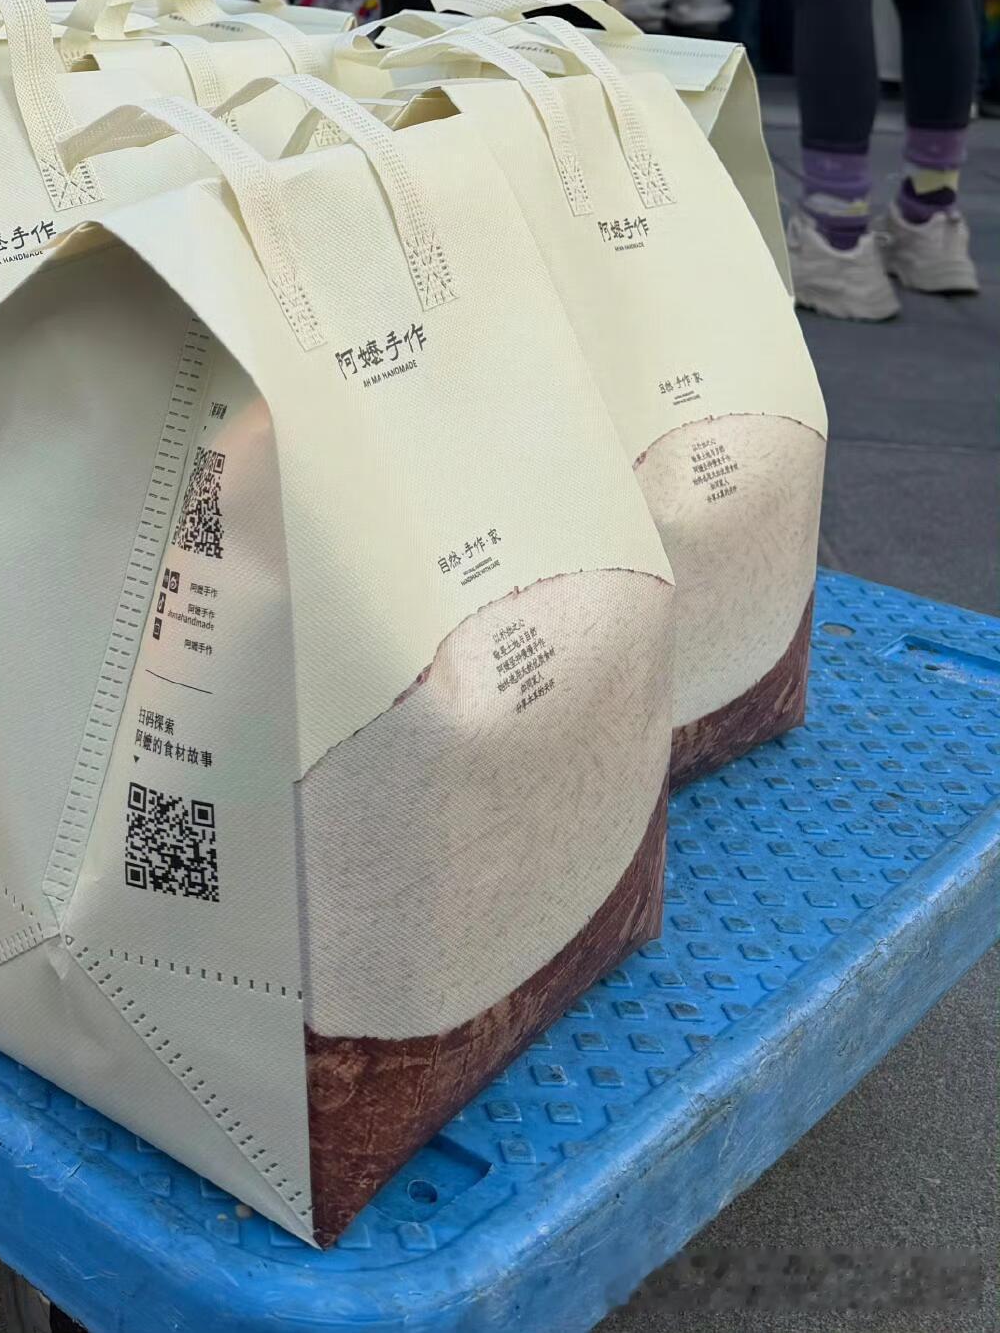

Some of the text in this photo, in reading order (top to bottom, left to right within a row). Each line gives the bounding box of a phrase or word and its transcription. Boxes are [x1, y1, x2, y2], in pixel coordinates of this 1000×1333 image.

[335, 323, 427, 381] 阿嬷手作
[382, 359, 418, 379] HANDMADE
[138, 706, 175, 736] 扫码探索
[134, 728, 213, 768] 阿嬷的食材故事
